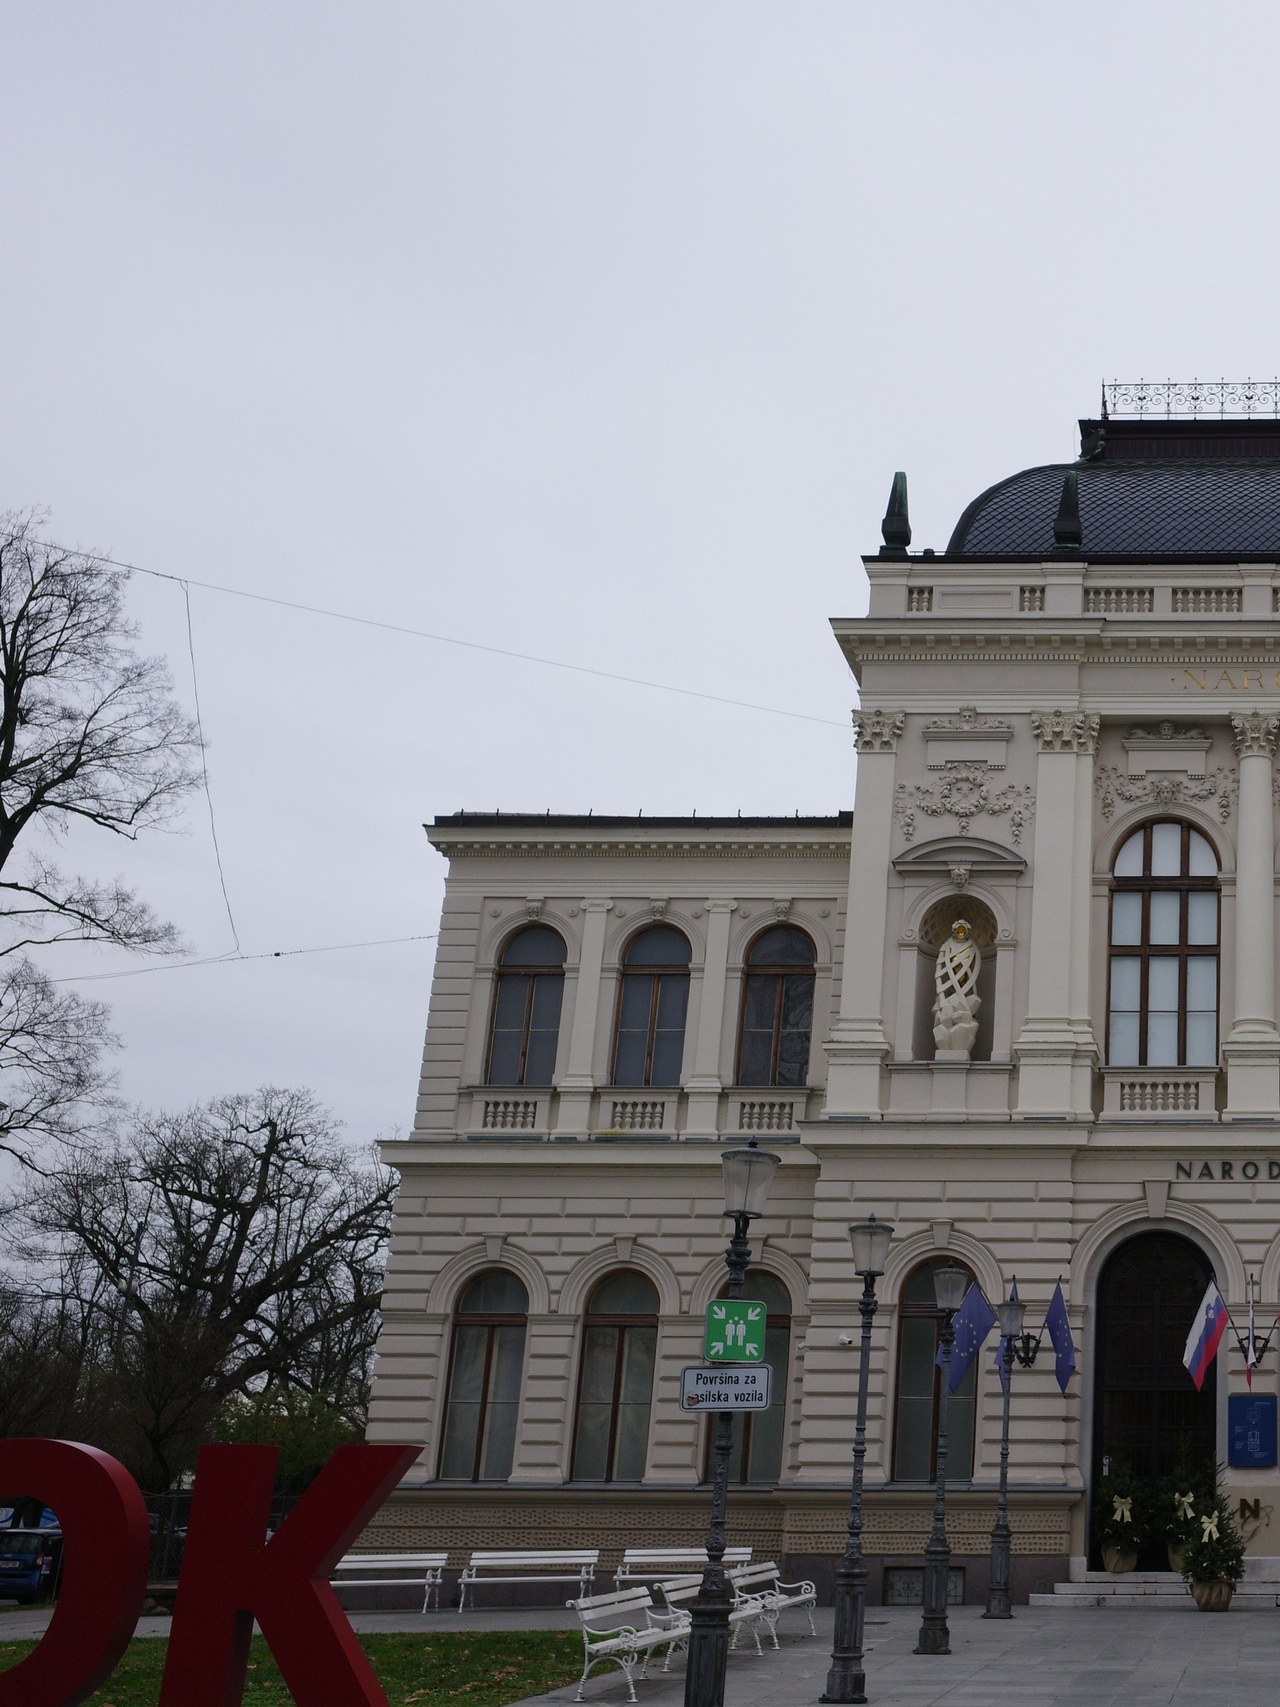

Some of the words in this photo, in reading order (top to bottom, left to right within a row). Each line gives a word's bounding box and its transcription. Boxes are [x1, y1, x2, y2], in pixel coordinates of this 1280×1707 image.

[695, 1372, 740, 1386] Površina
[744, 1374, 757, 1385] za
[688, 1390, 729, 1405] asilska
[734, 1389, 763, 1402] vozila
